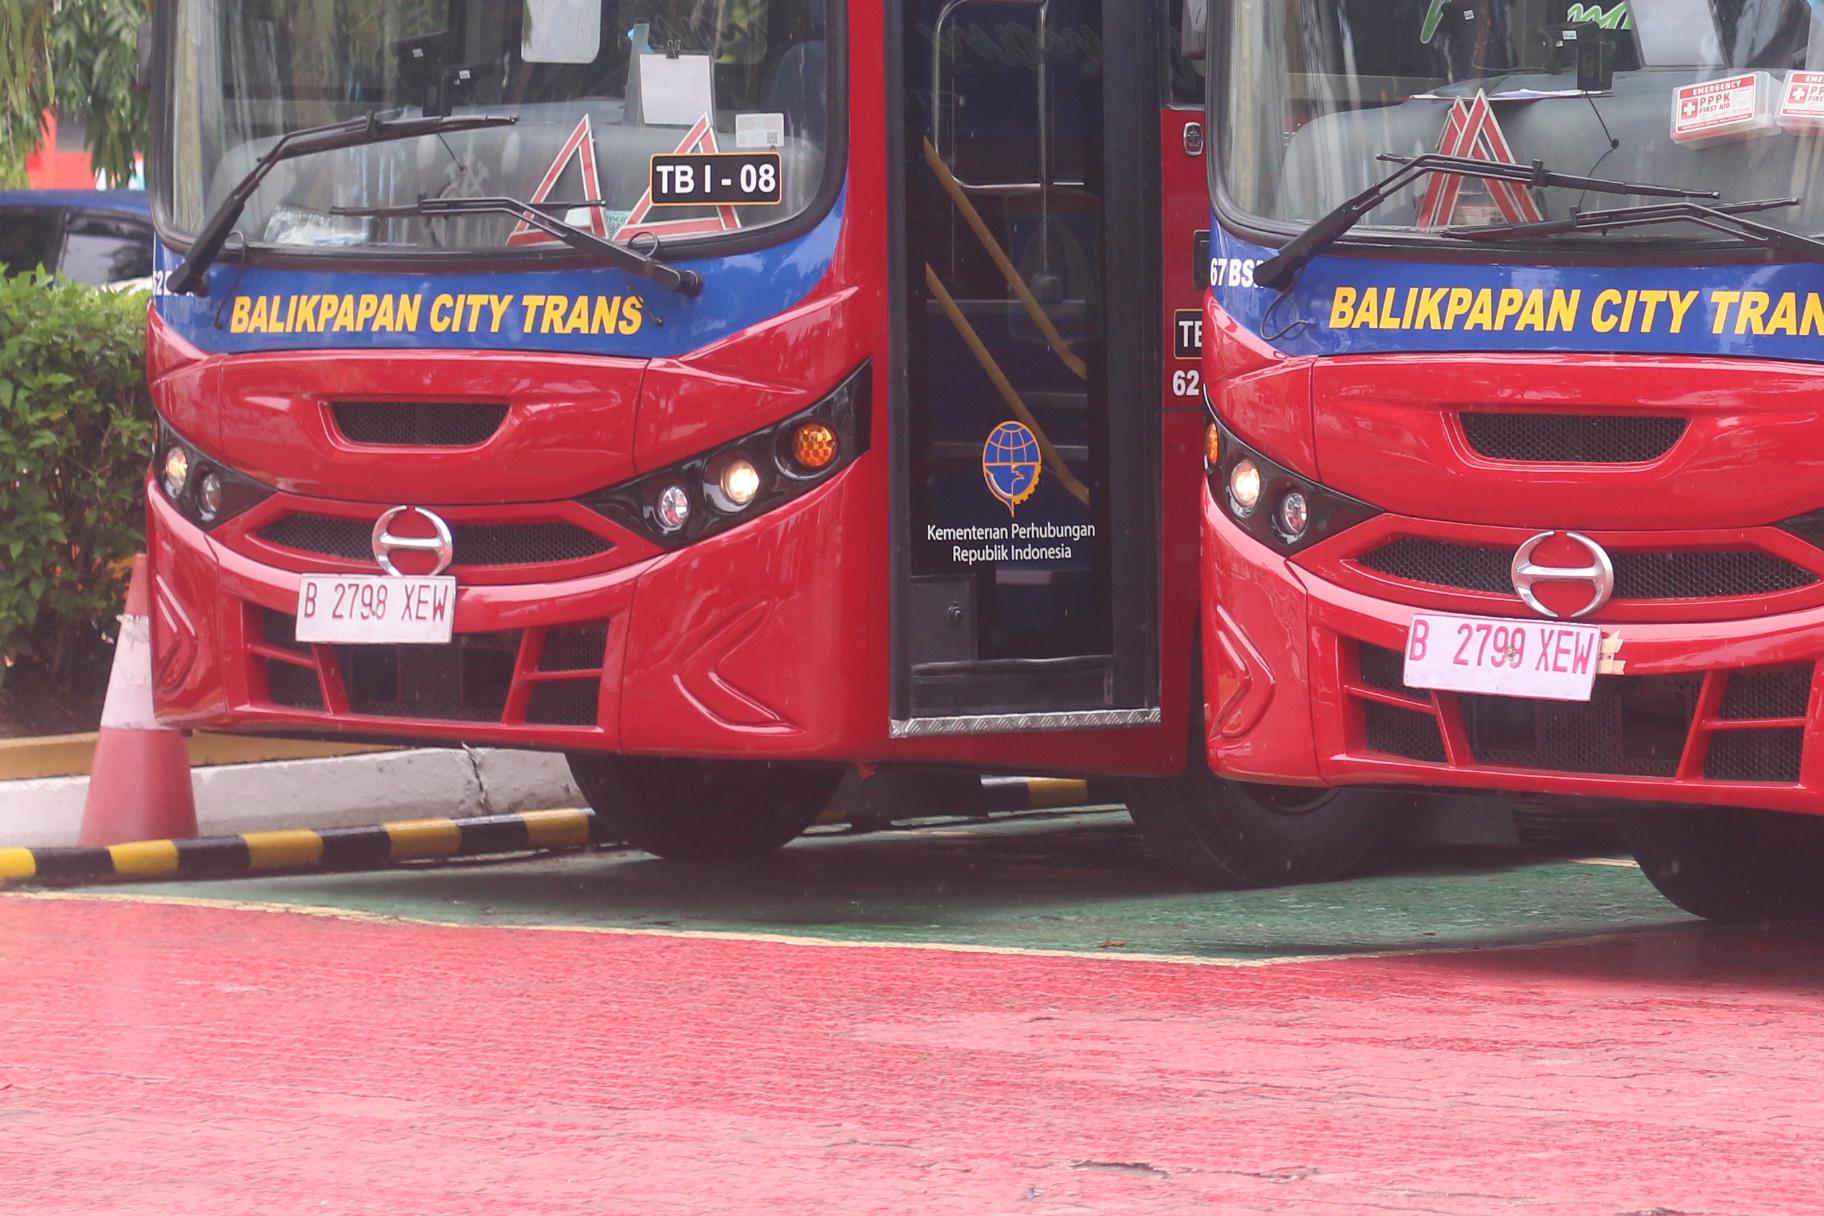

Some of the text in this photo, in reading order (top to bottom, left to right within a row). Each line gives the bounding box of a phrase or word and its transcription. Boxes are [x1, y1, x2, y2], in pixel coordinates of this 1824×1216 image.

[1692, 79, 1742, 96] EMERGENCY
[1700, 92, 1731, 105] PPPK
[656, 164, 696, 194] TB
[739, 163, 777, 193] 08
[1210, 257, 1265, 289] 67 BS
[230, 294, 644, 336] BALIKPAPAN CITY TRANS
[1330, 286, 1582, 332] BALIKPAPAN
[1590, 289, 1698, 334] CITY
[1172, 369, 1200, 397] 62
[927, 521, 1096, 542] Kementerian Perhubungan
[952, 543, 1072, 566] Republik Indonesia
[304, 582, 448, 622] B 2798 XEW
[1408, 618, 1595, 675] B 2799 XEW
